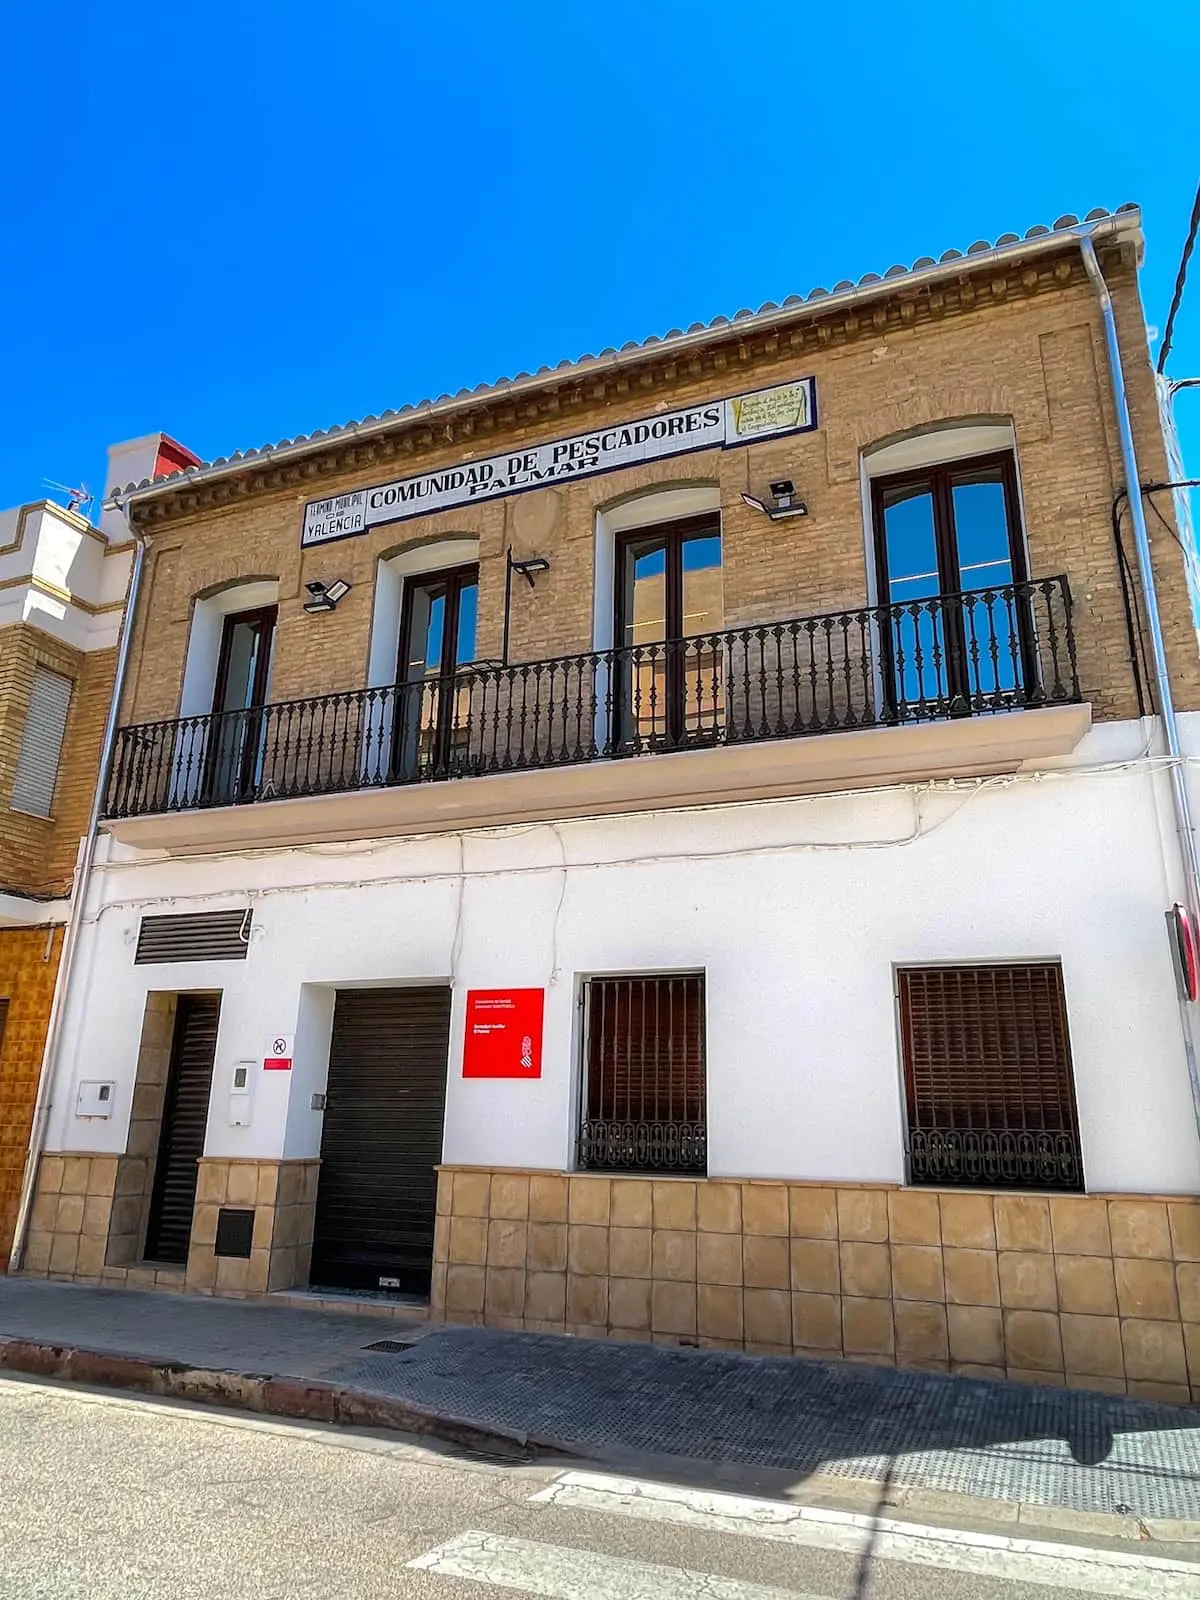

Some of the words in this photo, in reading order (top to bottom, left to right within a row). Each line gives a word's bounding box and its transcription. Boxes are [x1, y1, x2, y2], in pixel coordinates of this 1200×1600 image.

[370, 464, 494, 509] COMUNIDAD
[507, 452, 538, 476] DE
[553, 407, 720, 464] PESCADORES
[469, 456, 599, 496] PALMAR
[308, 514, 362, 537] VALENCIA
